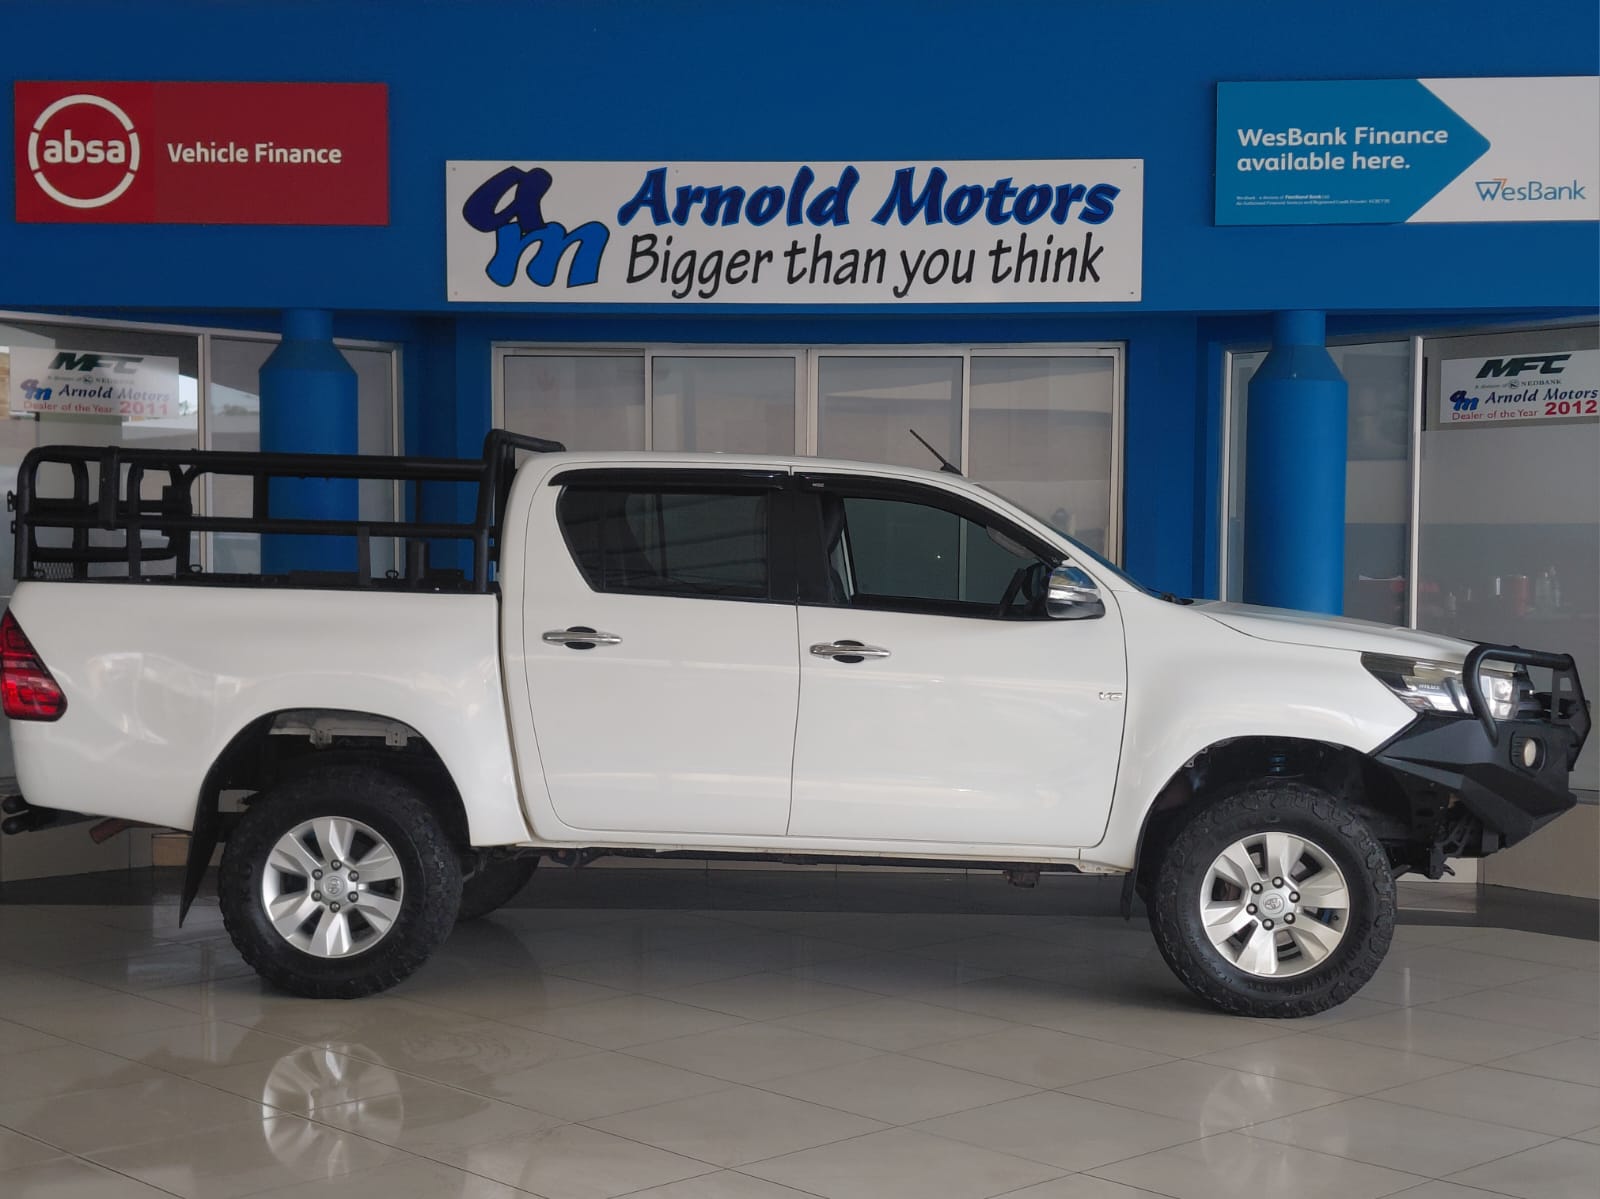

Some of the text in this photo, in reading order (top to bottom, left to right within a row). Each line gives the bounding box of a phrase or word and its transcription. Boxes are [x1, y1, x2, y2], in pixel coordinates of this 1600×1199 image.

[43, 129, 126, 164] absa
[1237, 126, 1449, 146] WesBank Finance
[167, 142, 342, 164] Vehicle Finance
[1236, 152, 1411, 171] available here.
[617, 165, 1121, 227] Arnold Motors
[1475, 178, 1587, 202] WesBank
[626, 231, 1105, 299] Bigger than you think
[48, 352, 144, 374] MFC
[1475, 354, 1572, 379] MFC
[58, 384, 171, 401] Arnold Motors
[1485, 388, 1599, 404] Arnold Motors
[24, 402, 168, 415] Dealer of the Year 2011
[1452, 400, 1598, 420] Dealer of the Year 2012
